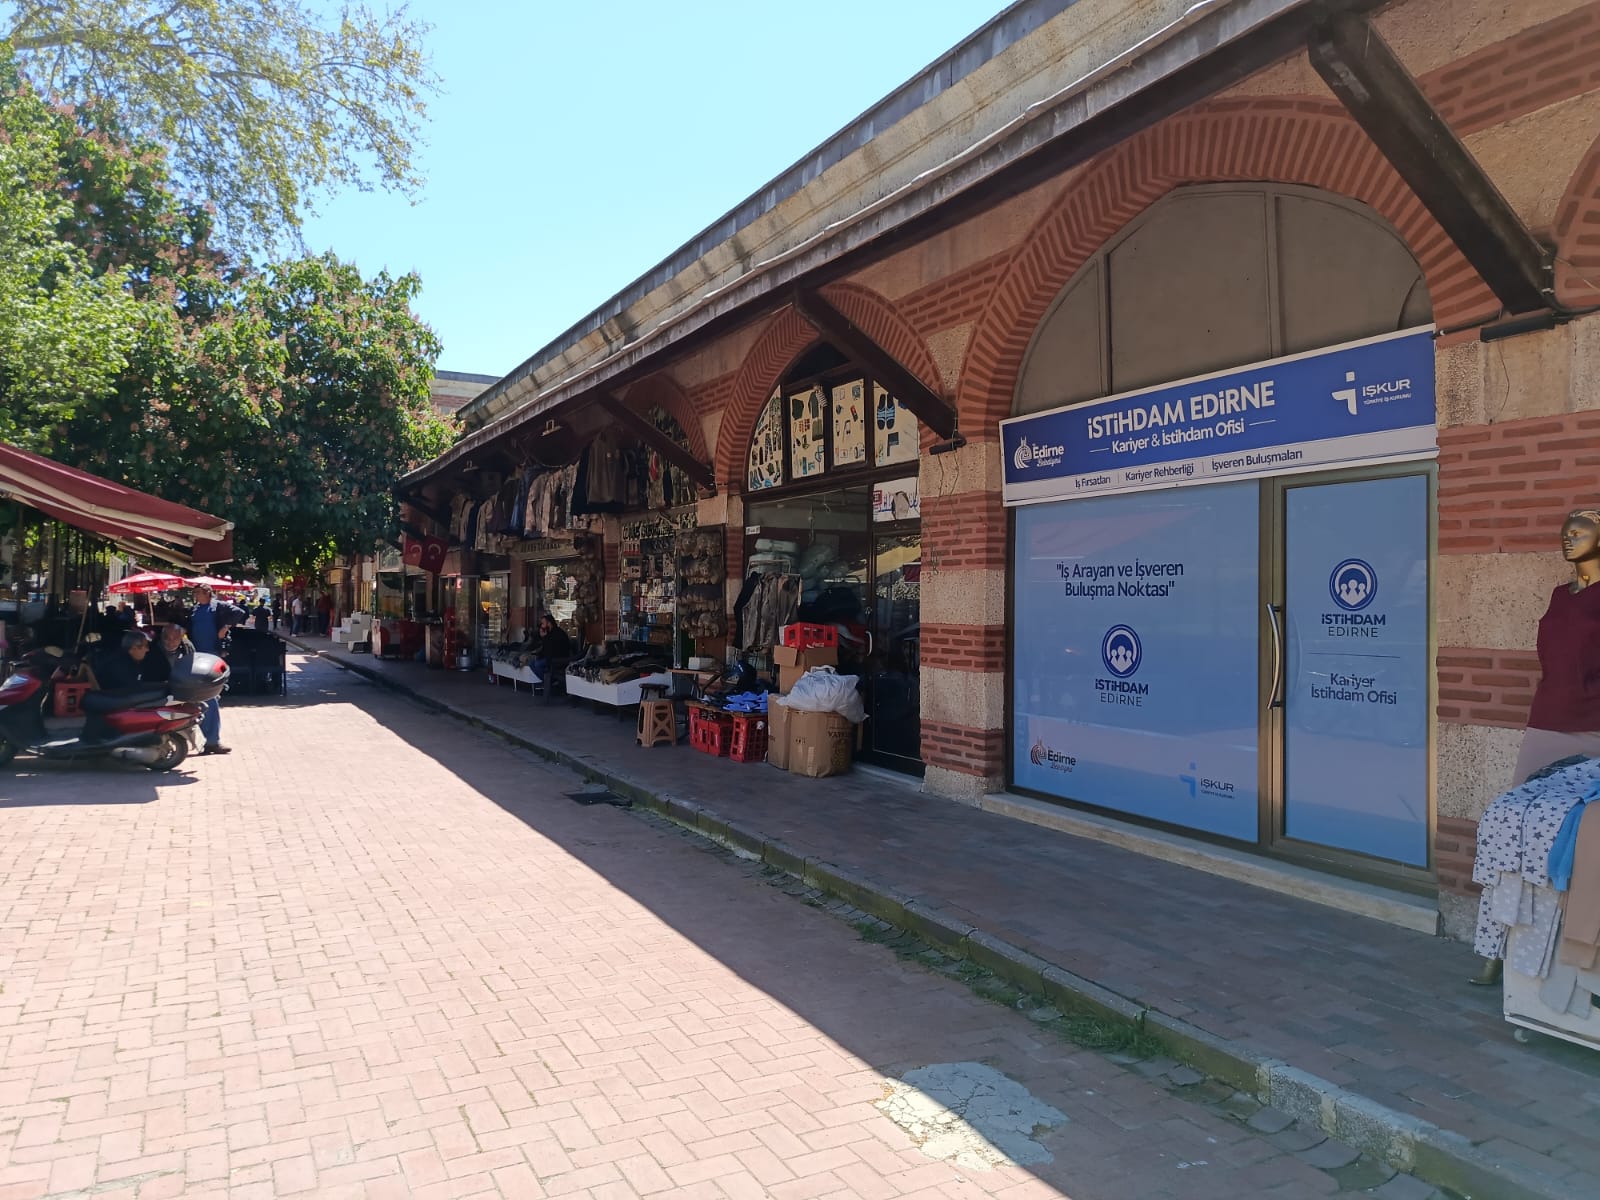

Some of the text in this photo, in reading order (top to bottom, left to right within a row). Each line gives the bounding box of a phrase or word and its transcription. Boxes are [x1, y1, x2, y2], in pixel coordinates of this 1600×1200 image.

[1112, 436, 1150, 454] Kariyer
[1151, 433, 1160, 446] &
[1215, 417, 1245, 436] Ofisi
[1033, 444, 1065, 459] Edirne
[1245, 449, 1303, 466] Buluşmaları
[1125, 462, 1195, 482] Kariyer Rehberliği
[1072, 563, 1114, 581] Arayan
[1117, 564, 1133, 577] ve
[1135, 558, 1184, 580] İşveren
[1065, 580, 1175, 600] Buluşma Noktası"
[1330, 672, 1376, 690] Kariyer
[1367, 690, 1397, 705] Ofisi
[1047, 749, 1077, 766] Edirne
